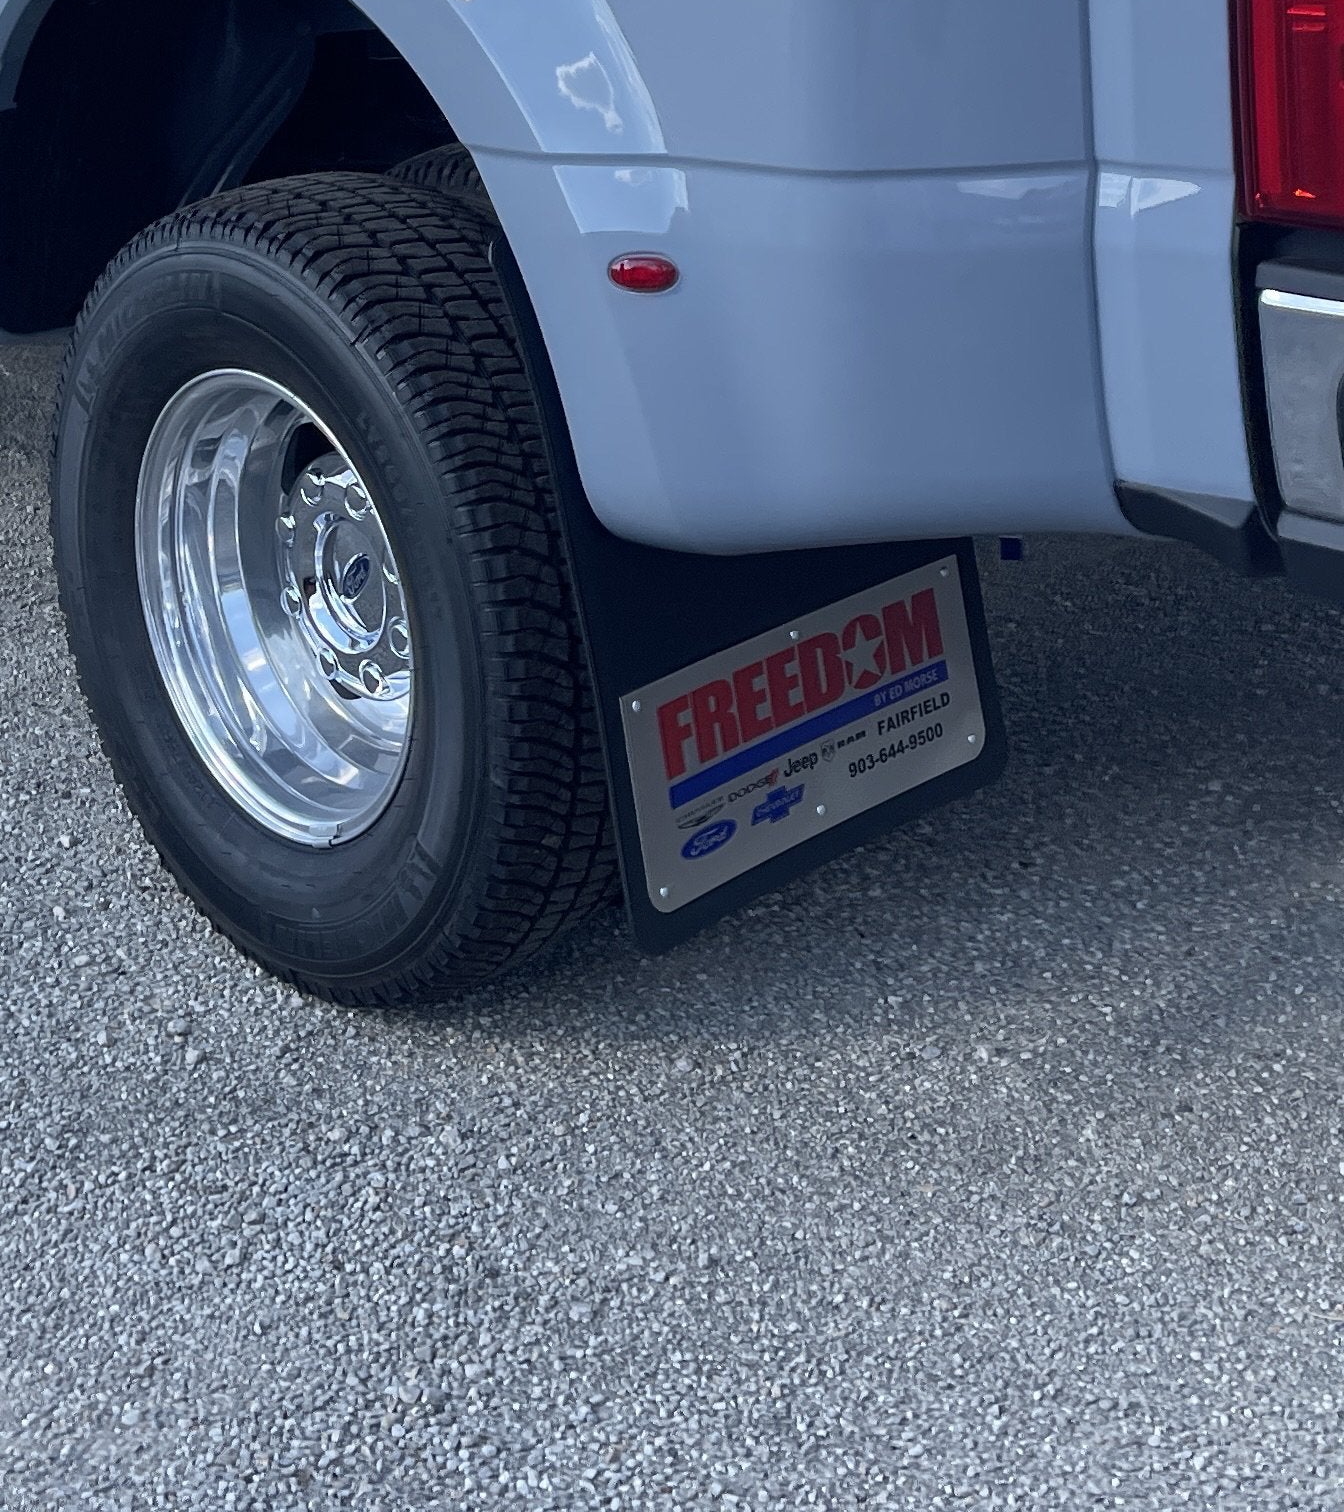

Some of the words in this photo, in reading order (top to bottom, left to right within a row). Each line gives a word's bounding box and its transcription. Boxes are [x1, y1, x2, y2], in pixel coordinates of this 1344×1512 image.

[657, 588, 944, 781] FREEDOM
[873, 690, 887, 707] BY
[888, 684, 903, 701] ED
[903, 668, 939, 695] MORSE
[877, 691, 950, 736] FAIRFIELD
[783, 752, 818, 778] Jeep
[848, 722, 943, 778] 903-644-9500
